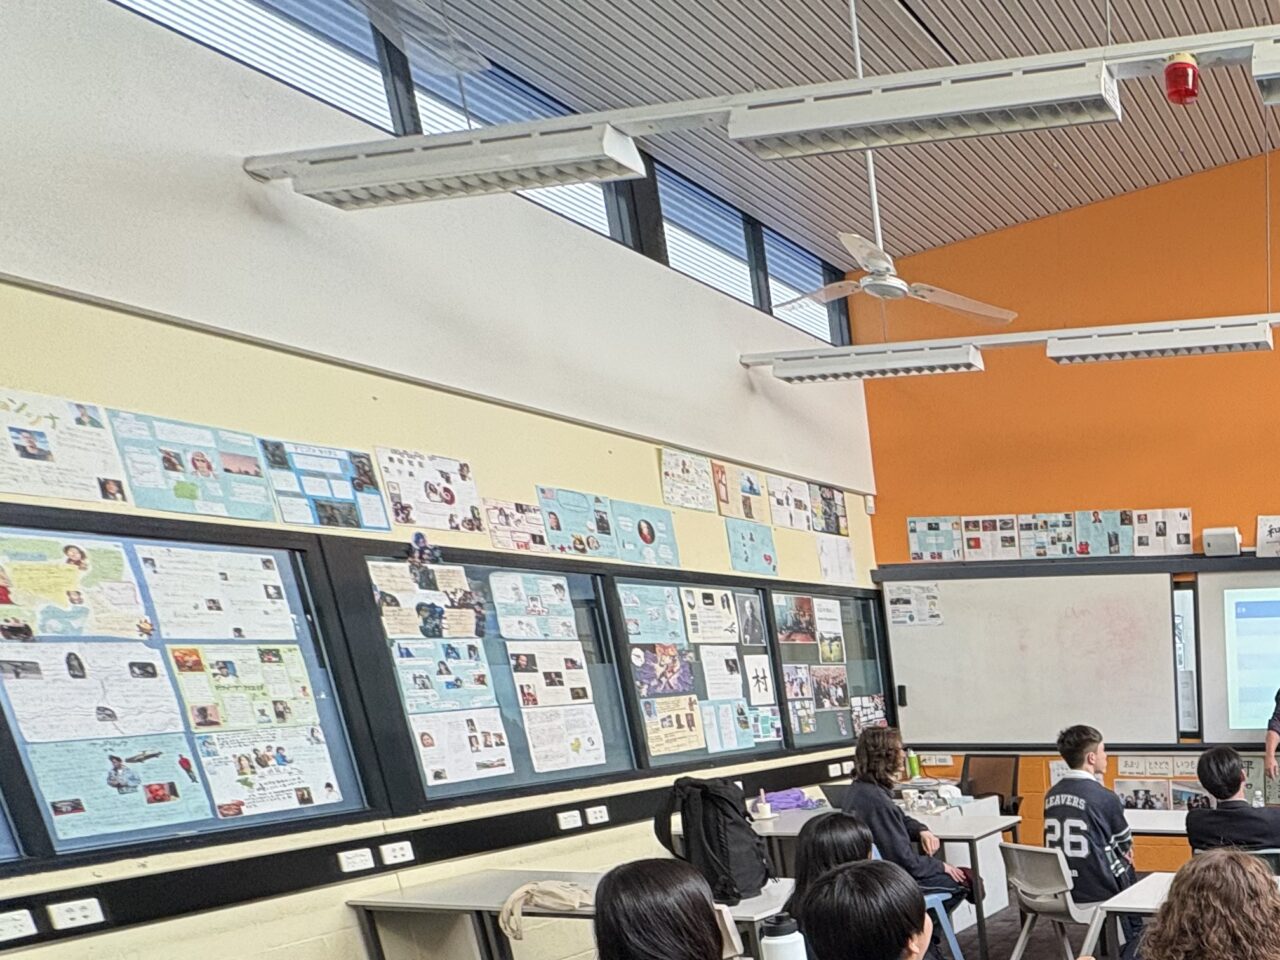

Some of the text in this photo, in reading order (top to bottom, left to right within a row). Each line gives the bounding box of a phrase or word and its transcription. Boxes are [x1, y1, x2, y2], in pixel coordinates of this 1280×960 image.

[752, 667, 769, 693] 村
[1044, 792, 1088, 812] LEAVERS
[1044, 817, 1090, 860] 26
